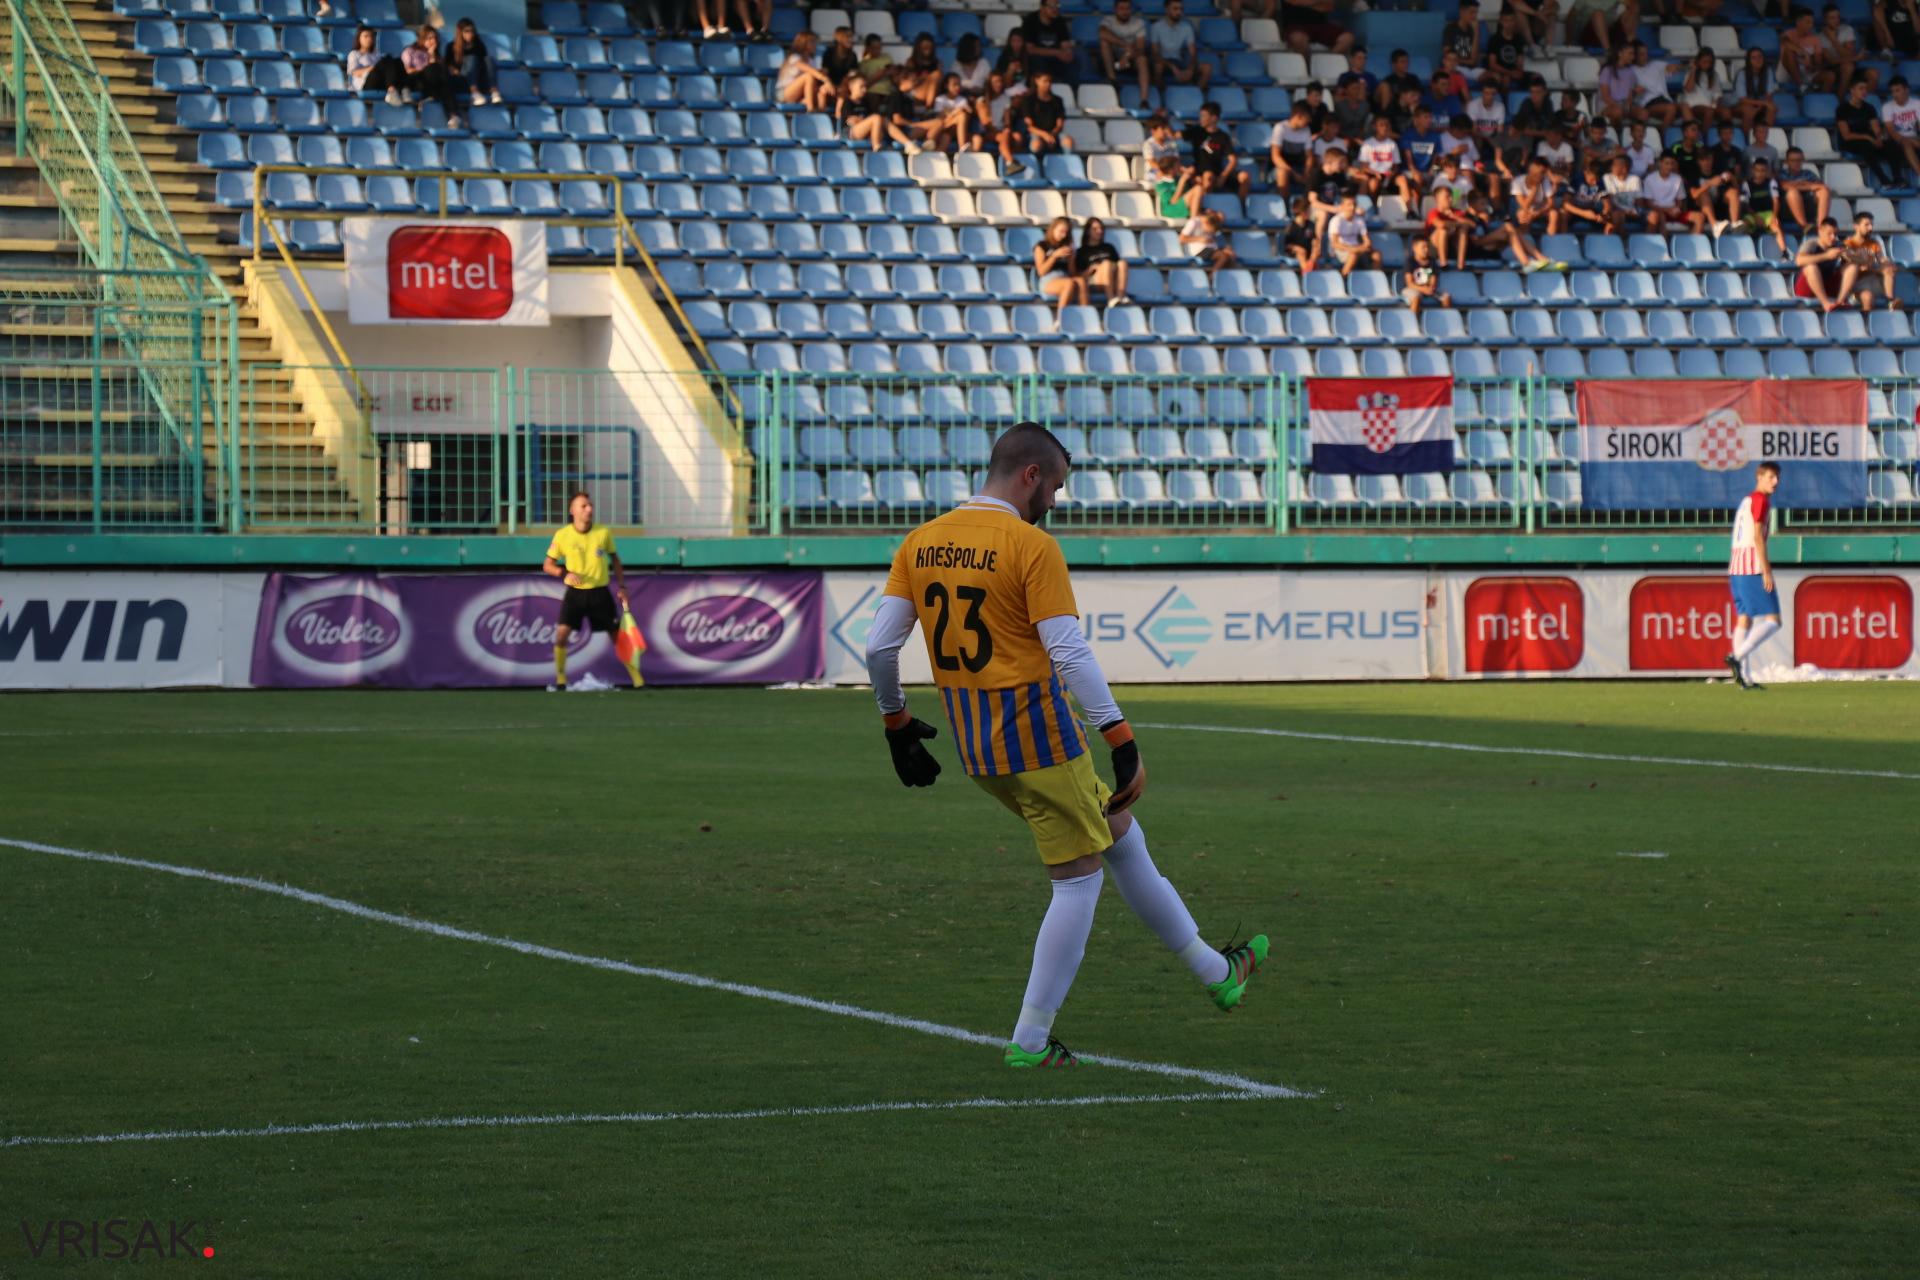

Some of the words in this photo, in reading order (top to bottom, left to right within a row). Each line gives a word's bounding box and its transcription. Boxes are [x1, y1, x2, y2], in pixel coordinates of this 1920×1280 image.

[401, 254, 498, 290] m:tel
[412, 397, 453, 412] EXIT
[1606, 427, 1683, 459] ŠIROKI
[1761, 431, 1840, 457] BRIJEG
[299, 612, 386, 645] Violeta
[680, 611, 771, 643] Violeta
[924, 581, 993, 674] 23
[1224, 610, 1421, 641] EMERUS
[1477, 603, 1570, 641] m:tel
[1641, 603, 1734, 640] m:tel
[1806, 602, 1899, 640] m:tel
